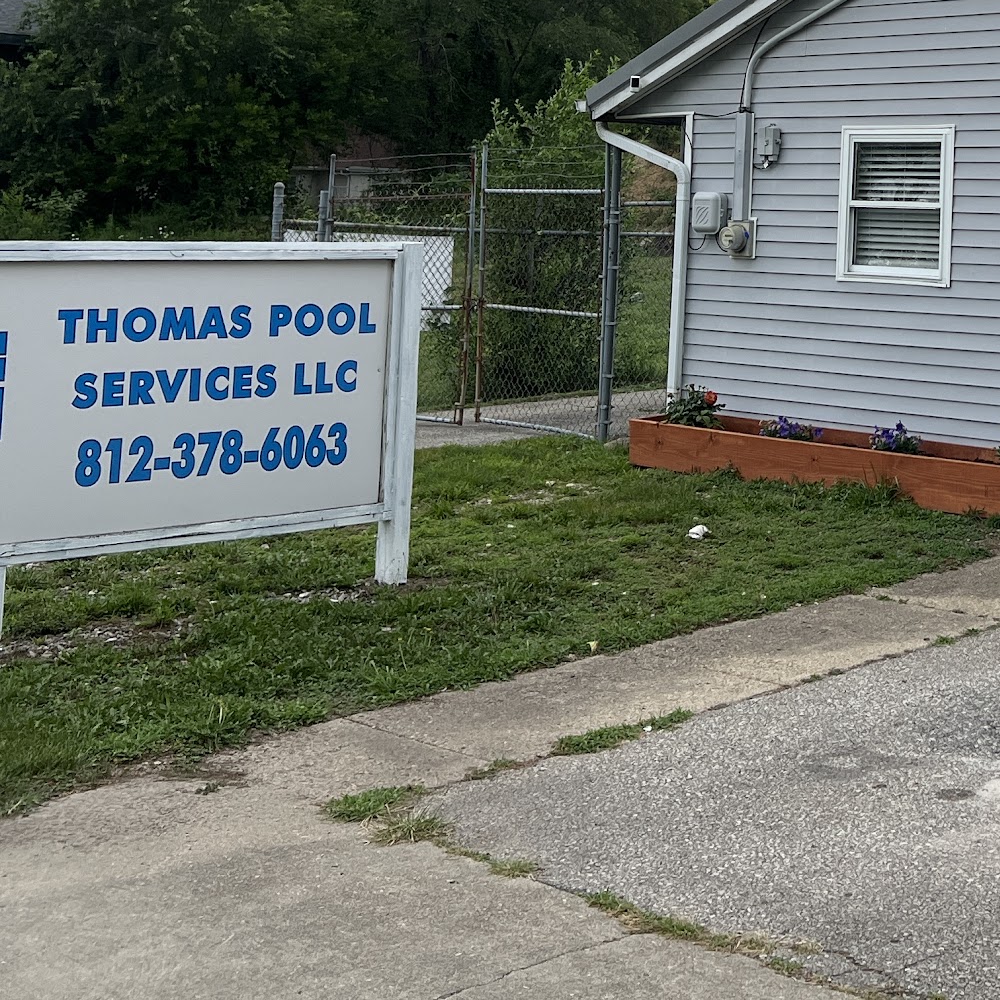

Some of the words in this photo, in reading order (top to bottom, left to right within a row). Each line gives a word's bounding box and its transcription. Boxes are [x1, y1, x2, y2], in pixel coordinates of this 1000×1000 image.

[58, 304, 252, 344] THOMAS
[269, 302, 376, 337] POOL
[71, 364, 277, 409] SERVICES
[294, 360, 358, 395] LLC
[74, 422, 348, 487] 812-378-6063
